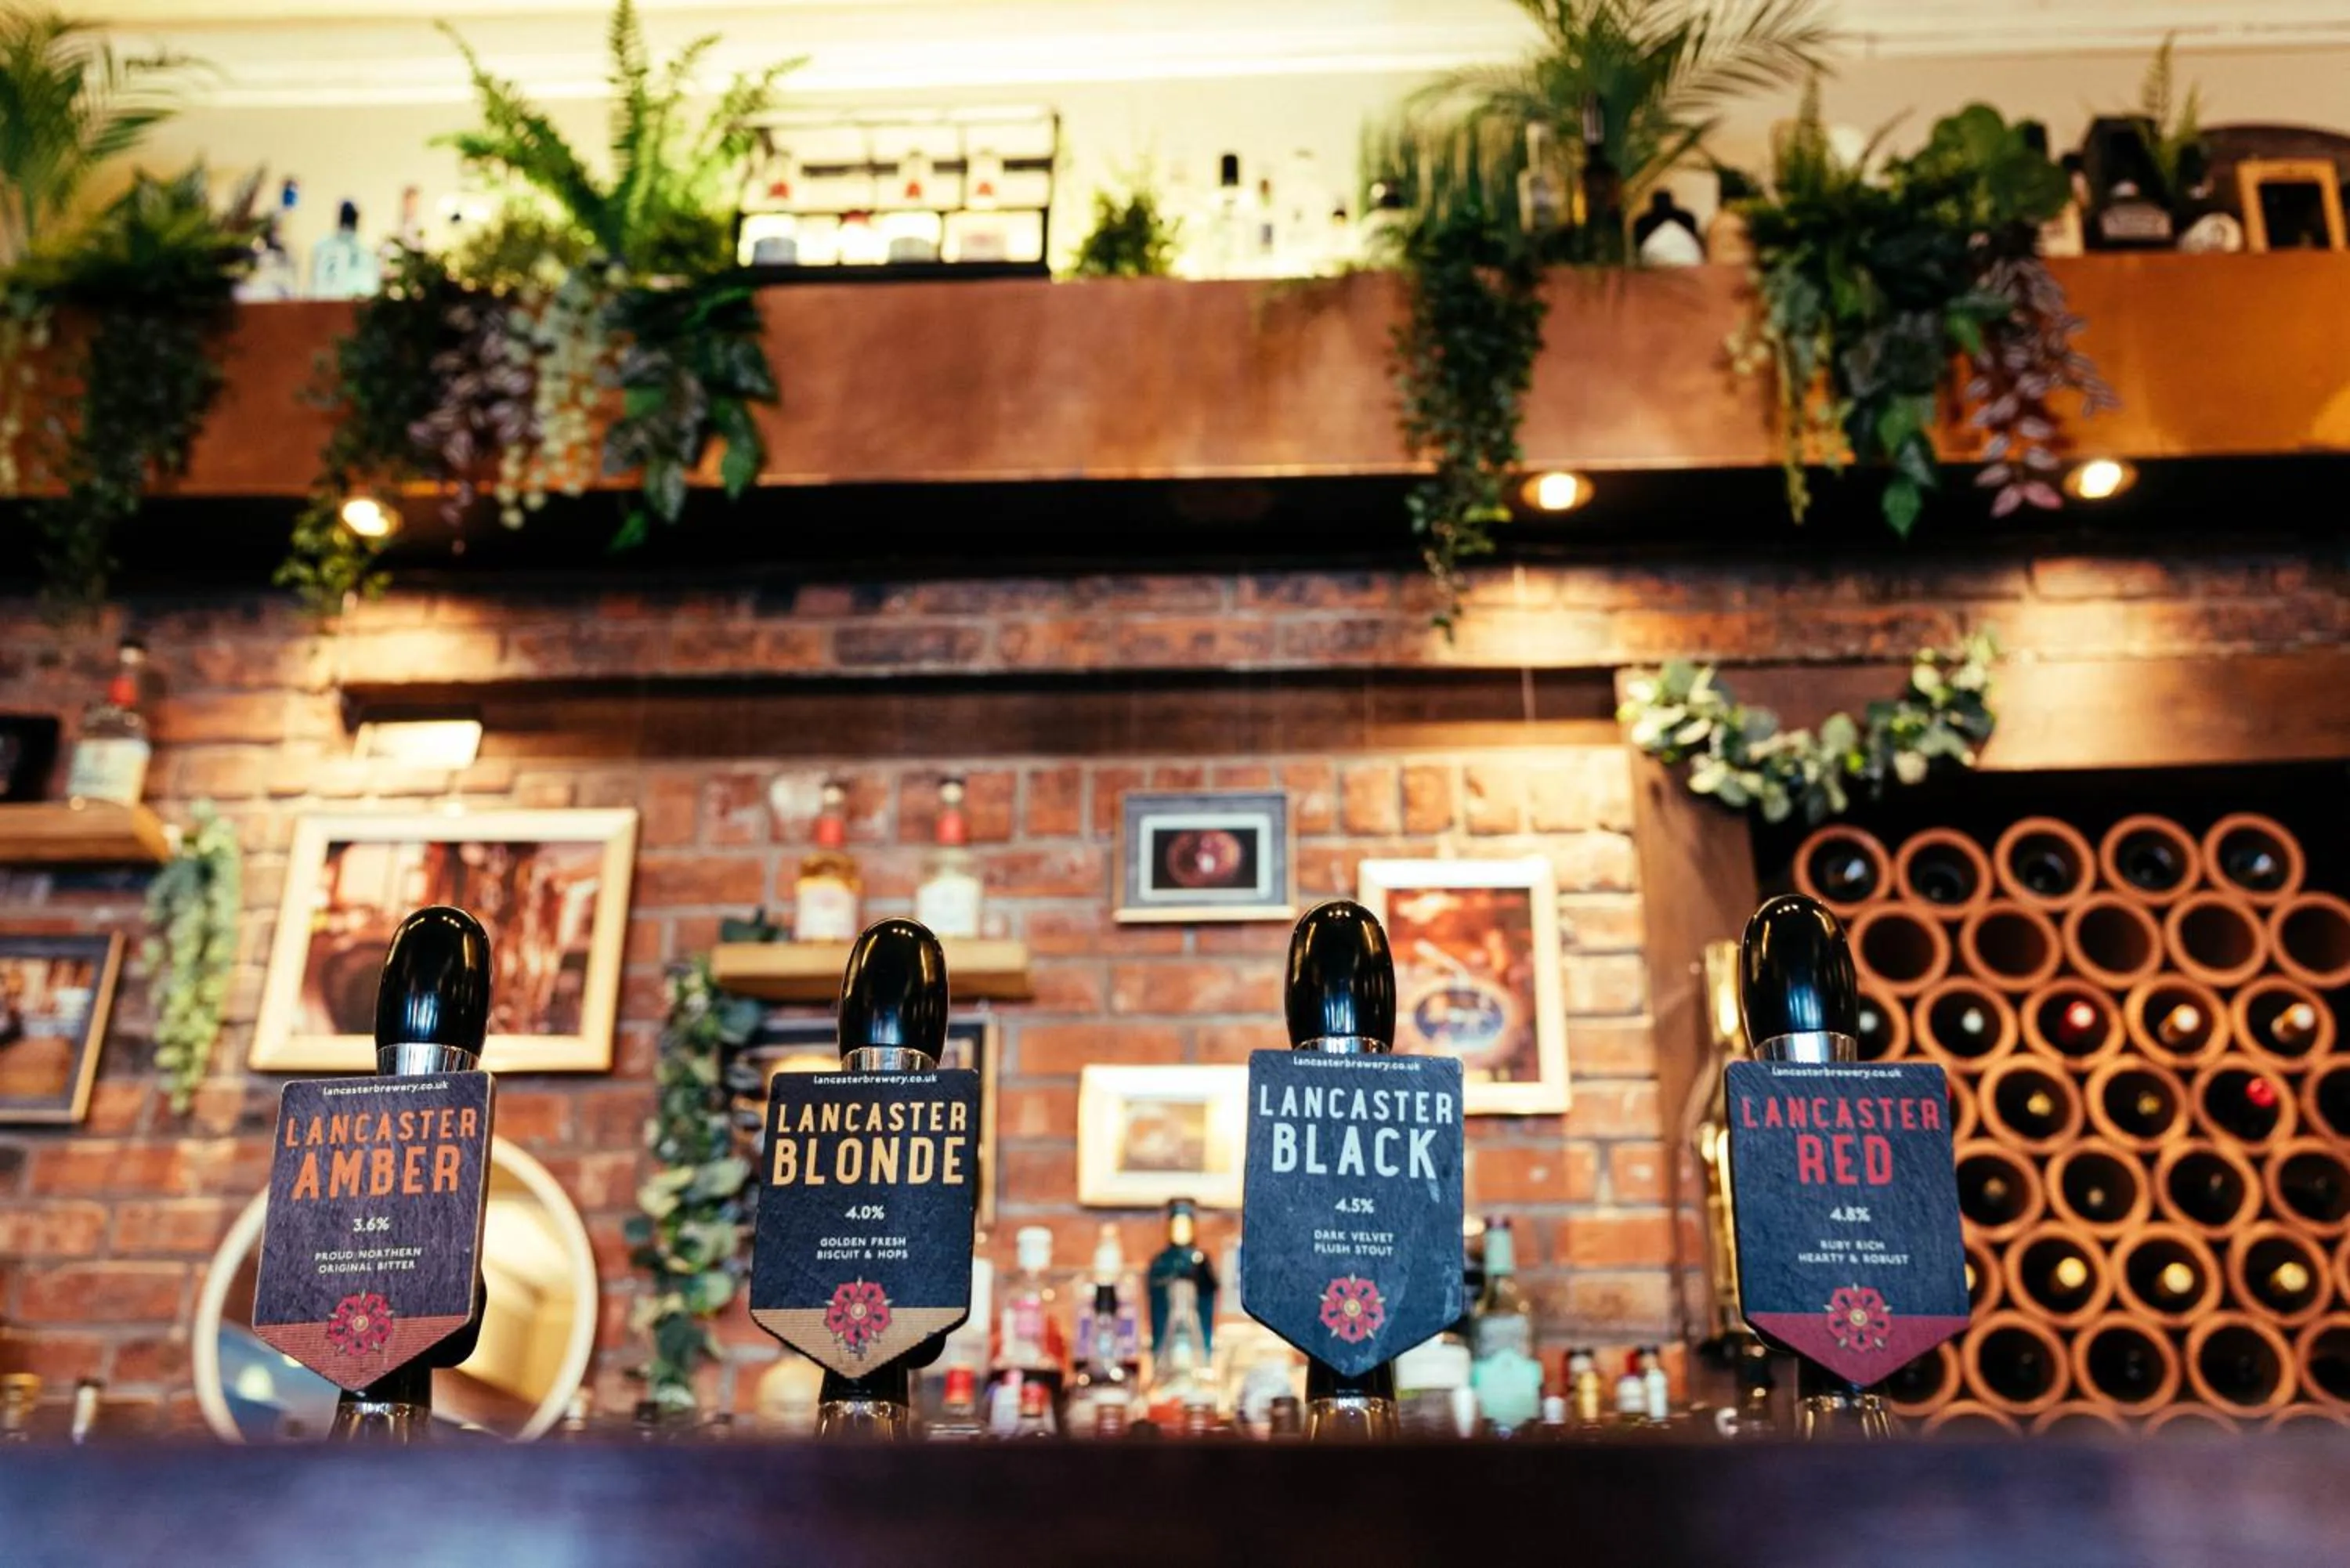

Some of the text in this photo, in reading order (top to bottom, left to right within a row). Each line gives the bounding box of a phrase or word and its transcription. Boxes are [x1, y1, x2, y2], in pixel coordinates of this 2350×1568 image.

[1293, 1056, 1420, 1071] lancasterbrewery.co.uk
[814, 1074, 937, 1085] lancasterbrewery.co.uk
[323, 1080, 449, 1096] lancasterbrewery.co.uk
[1260, 1085, 1452, 1123] LANCASTER
[777, 1102, 967, 1133] LANCASTER
[1742, 1097, 1940, 1129] LANCASTER
[285, 1107, 477, 1147] LANCASTER
[1272, 1122, 1437, 1180] BLACK
[772, 1136, 966, 1185] BLONDE
[1797, 1135, 1893, 1185] RED
[291, 1144, 461, 1201] AMBER
[844, 1206, 884, 1219] 4.0%
[1335, 1198, 1374, 1213] 4.5%
[1830, 1207, 1871, 1222] 4.8%
[353, 1217, 389, 1232] 3.6%
[820, 1237, 906, 1247] GOLDEN FRESH
[1314, 1230, 1394, 1242] DARK VELVET
[1314, 1244, 1393, 1255] PLUSH STOUT
[1820, 1240, 1885, 1251] RUBY RICH
[315, 1248, 422, 1261] PROUD NORTHERN
[817, 1250, 859, 1259] BISCUIT
[877, 1249, 908, 1259] HOPS
[1799, 1254, 1844, 1263] HEARTY
[1864, 1255, 1909, 1264] ROBUST
[319, 1260, 416, 1274] ORIGINAL BITTER
